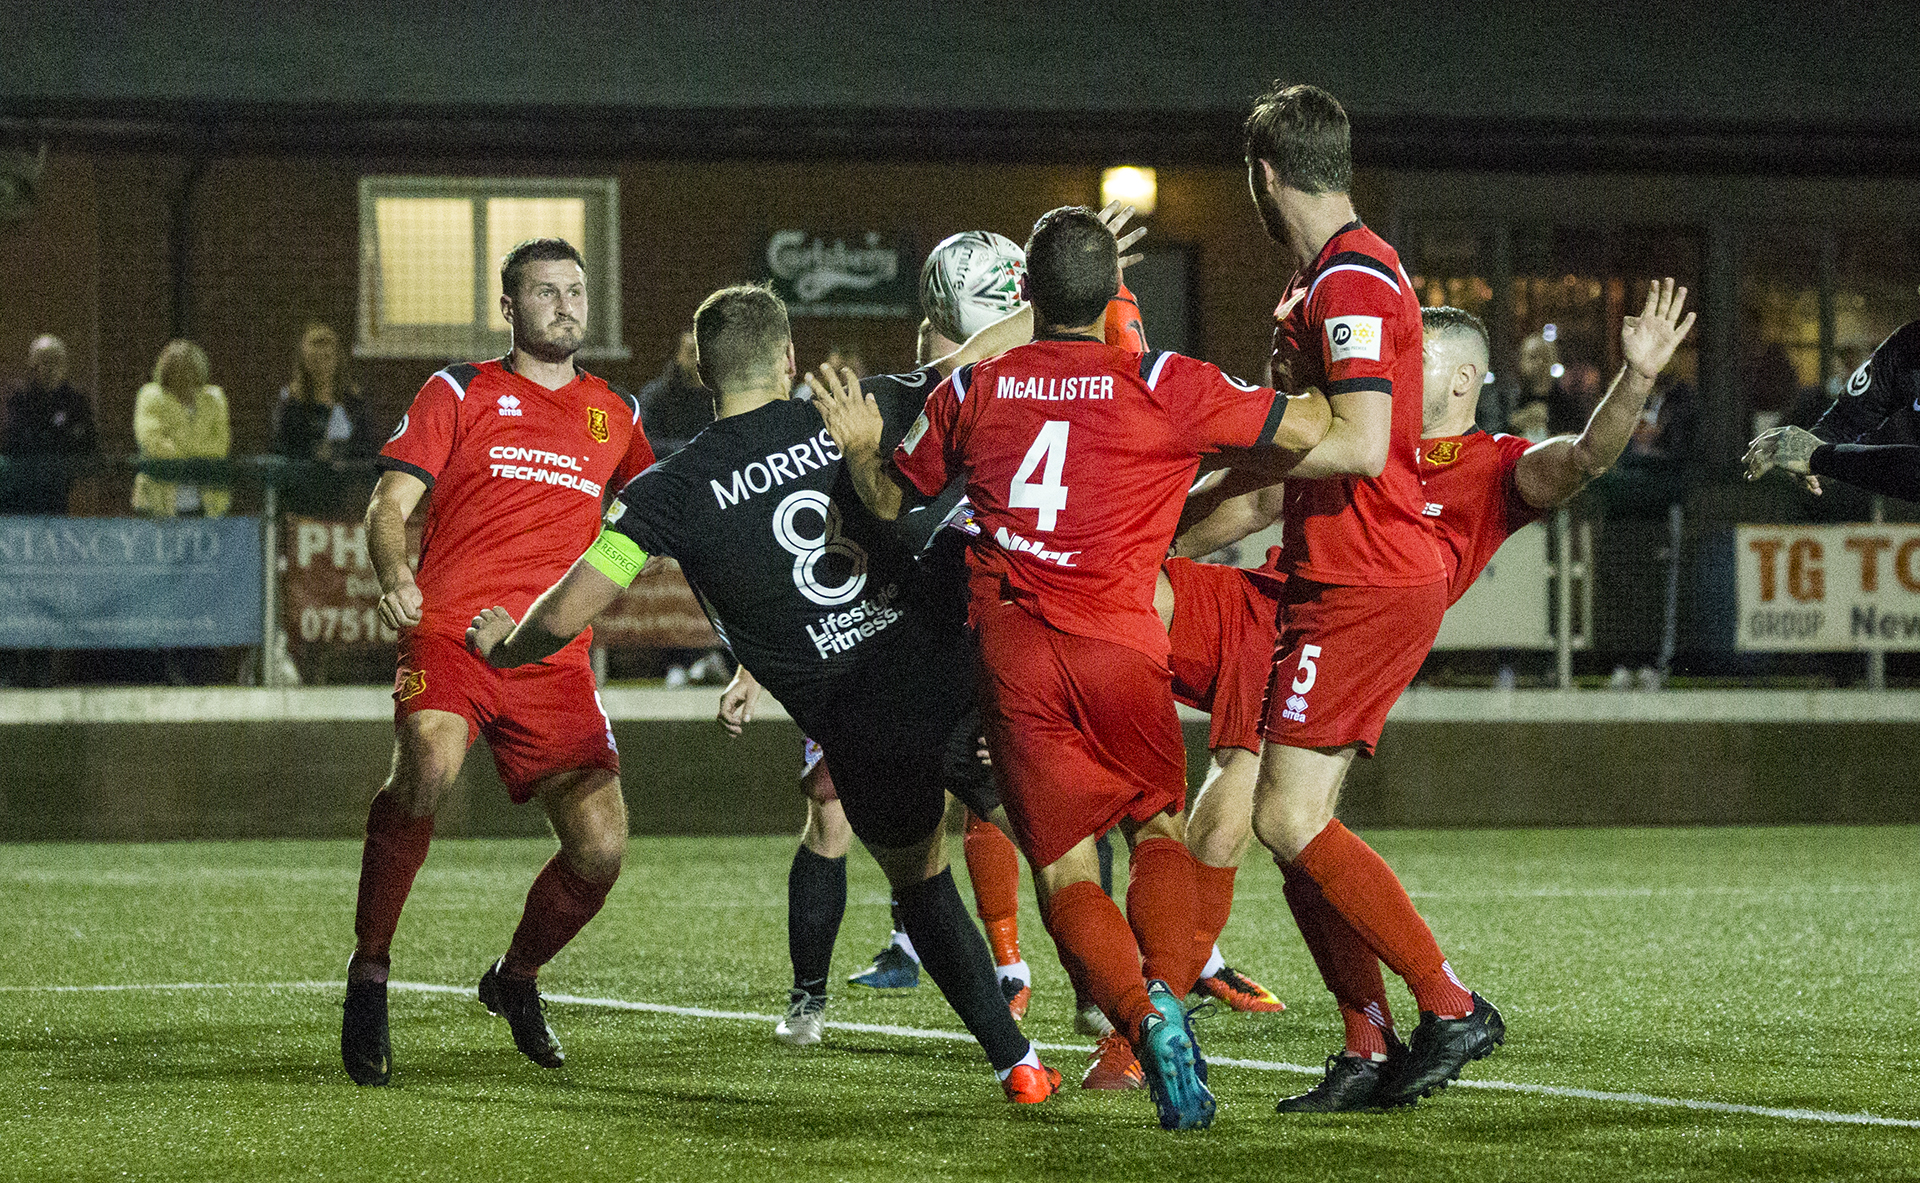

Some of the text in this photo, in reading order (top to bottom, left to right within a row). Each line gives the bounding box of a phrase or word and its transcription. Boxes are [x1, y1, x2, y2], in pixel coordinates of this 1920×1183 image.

[767, 229, 899, 299] Carlsberg
[952, 247, 974, 291] mitre
[1334, 327, 1350, 341] JD
[996, 375, 1114, 401] McALLISTER
[489, 446, 582, 472] CONTROL
[489, 464, 602, 498] TECHNIQUES
[710, 427, 843, 510] MORRIS
[1008, 420, 1070, 532] 4
[600, 543, 637, 573] RESPECT
[772, 489, 869, 606] 8
[1750, 537, 1824, 602] TG
[805, 582, 898, 643] Lifestyle
[1749, 612, 1825, 638] GROUP
[1291, 644, 1322, 695] 5
